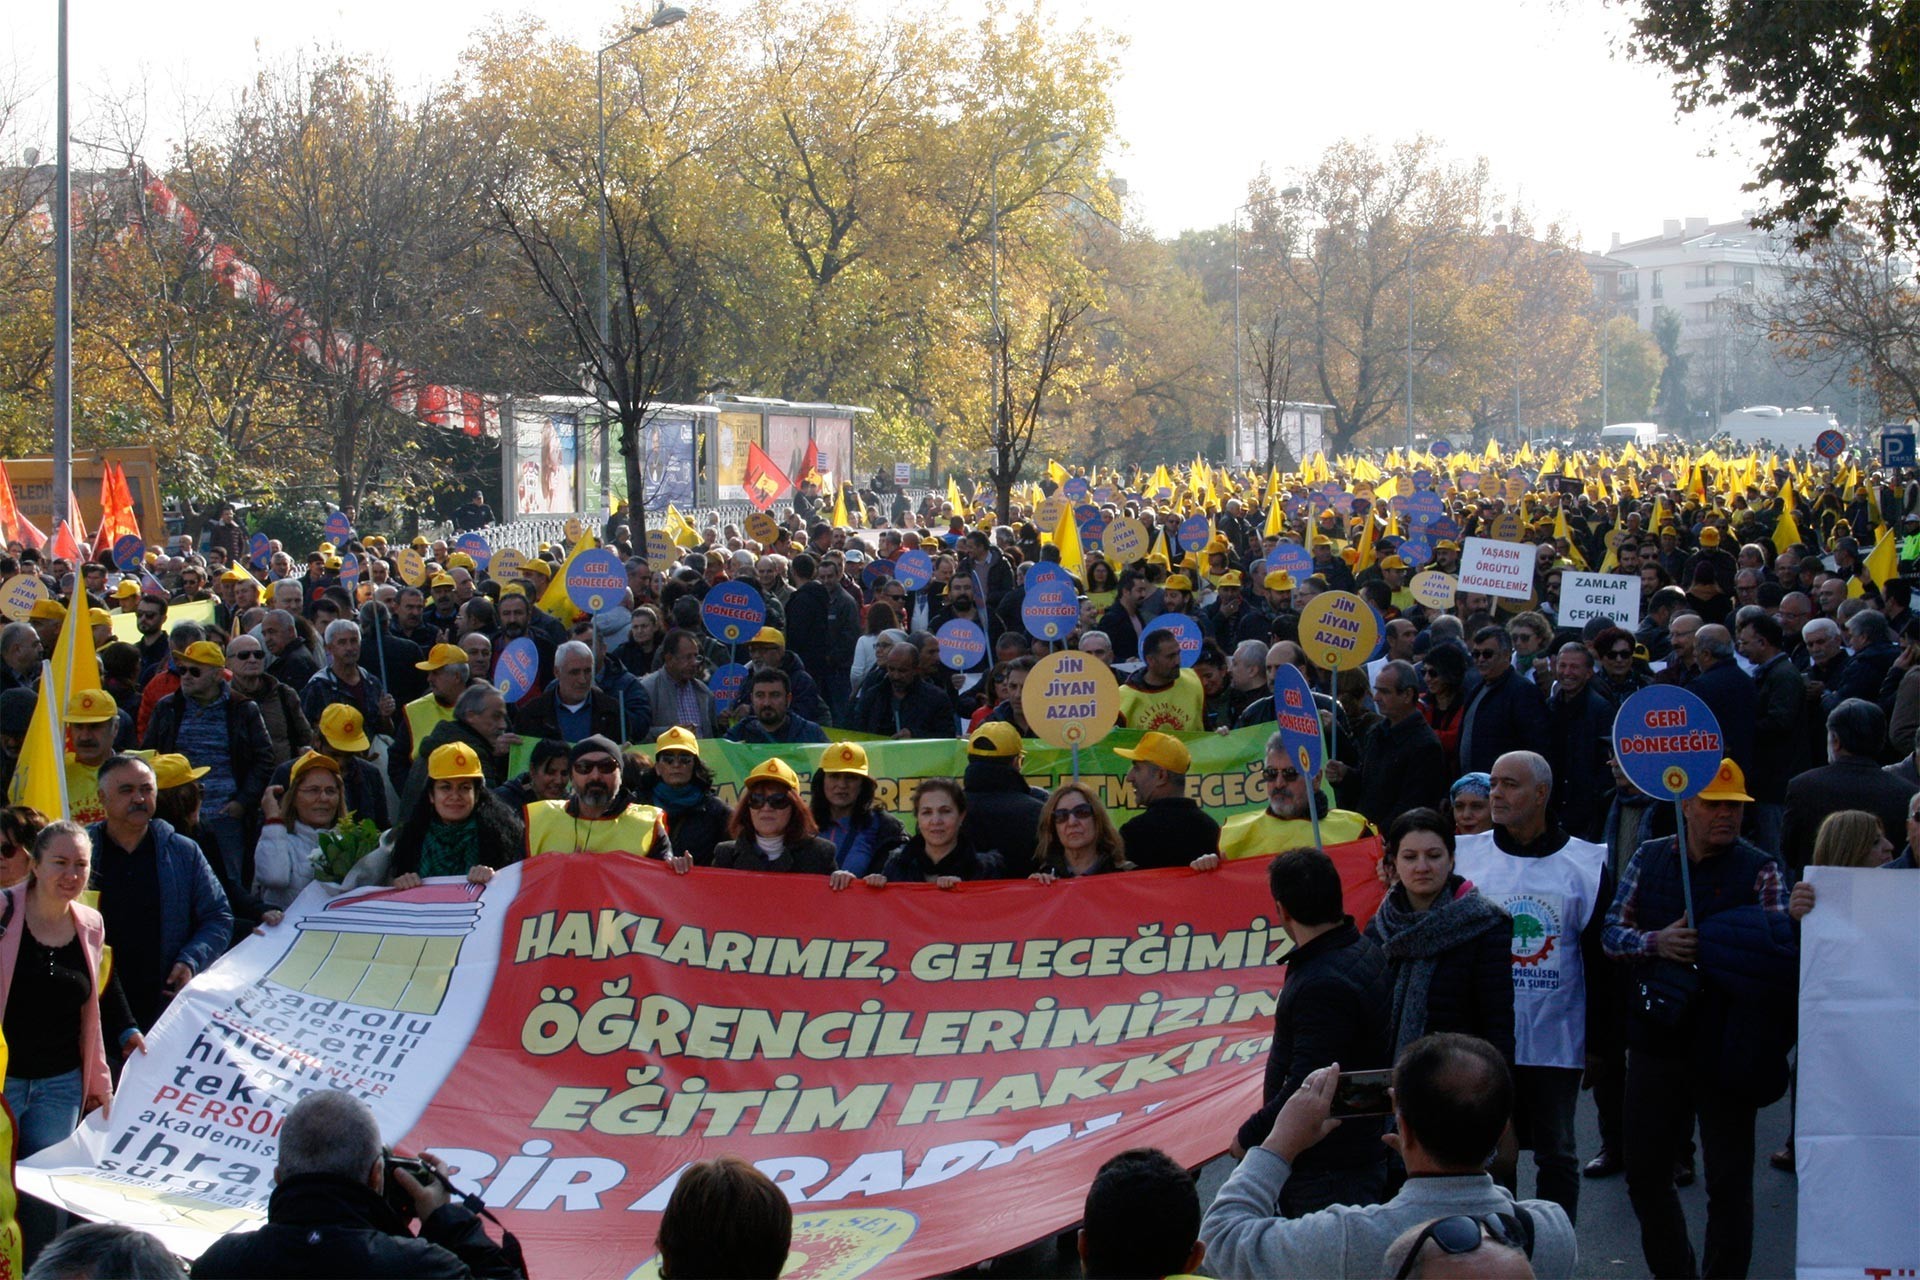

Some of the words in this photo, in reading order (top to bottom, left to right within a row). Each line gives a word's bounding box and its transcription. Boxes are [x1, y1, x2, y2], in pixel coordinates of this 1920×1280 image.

[1884, 438, 1904, 466] P
[1481, 546, 1520, 560] YAŞASIN
[584, 562, 609, 574] GERİ
[1475, 562, 1520, 576] ÖRGÜTLÜ
[1462, 575, 1528, 592] MÜCADELEMİZ
[1575, 577, 1628, 590] ZAMLAR
[722, 592, 749, 606] GERİ
[1585, 593, 1616, 606] GERİ
[705, 604, 763, 624] DÖNECEĞİZ
[1644, 705, 1687, 729] GERİ
[1620, 729, 1720, 756] DÖNECEĞİZ
[514, 908, 896, 984] HAKLARIMIZ,
[910, 916, 1297, 982] GELECEĞİMİZ
[253, 977, 432, 1036] kadrolu
[521, 976, 1283, 1061] ÖĞRENCİLERİMİZİN
[173, 1065, 294, 1114] tekn
[529, 1064, 893, 1138] EĞİTİM
[896, 1036, 1222, 1126] HAKKI
[139, 1109, 279, 1162] akademis
[111, 1126, 276, 1190] ihra
[97, 1159, 269, 1201] sürgü
[424, 1138, 628, 1212] BİR
